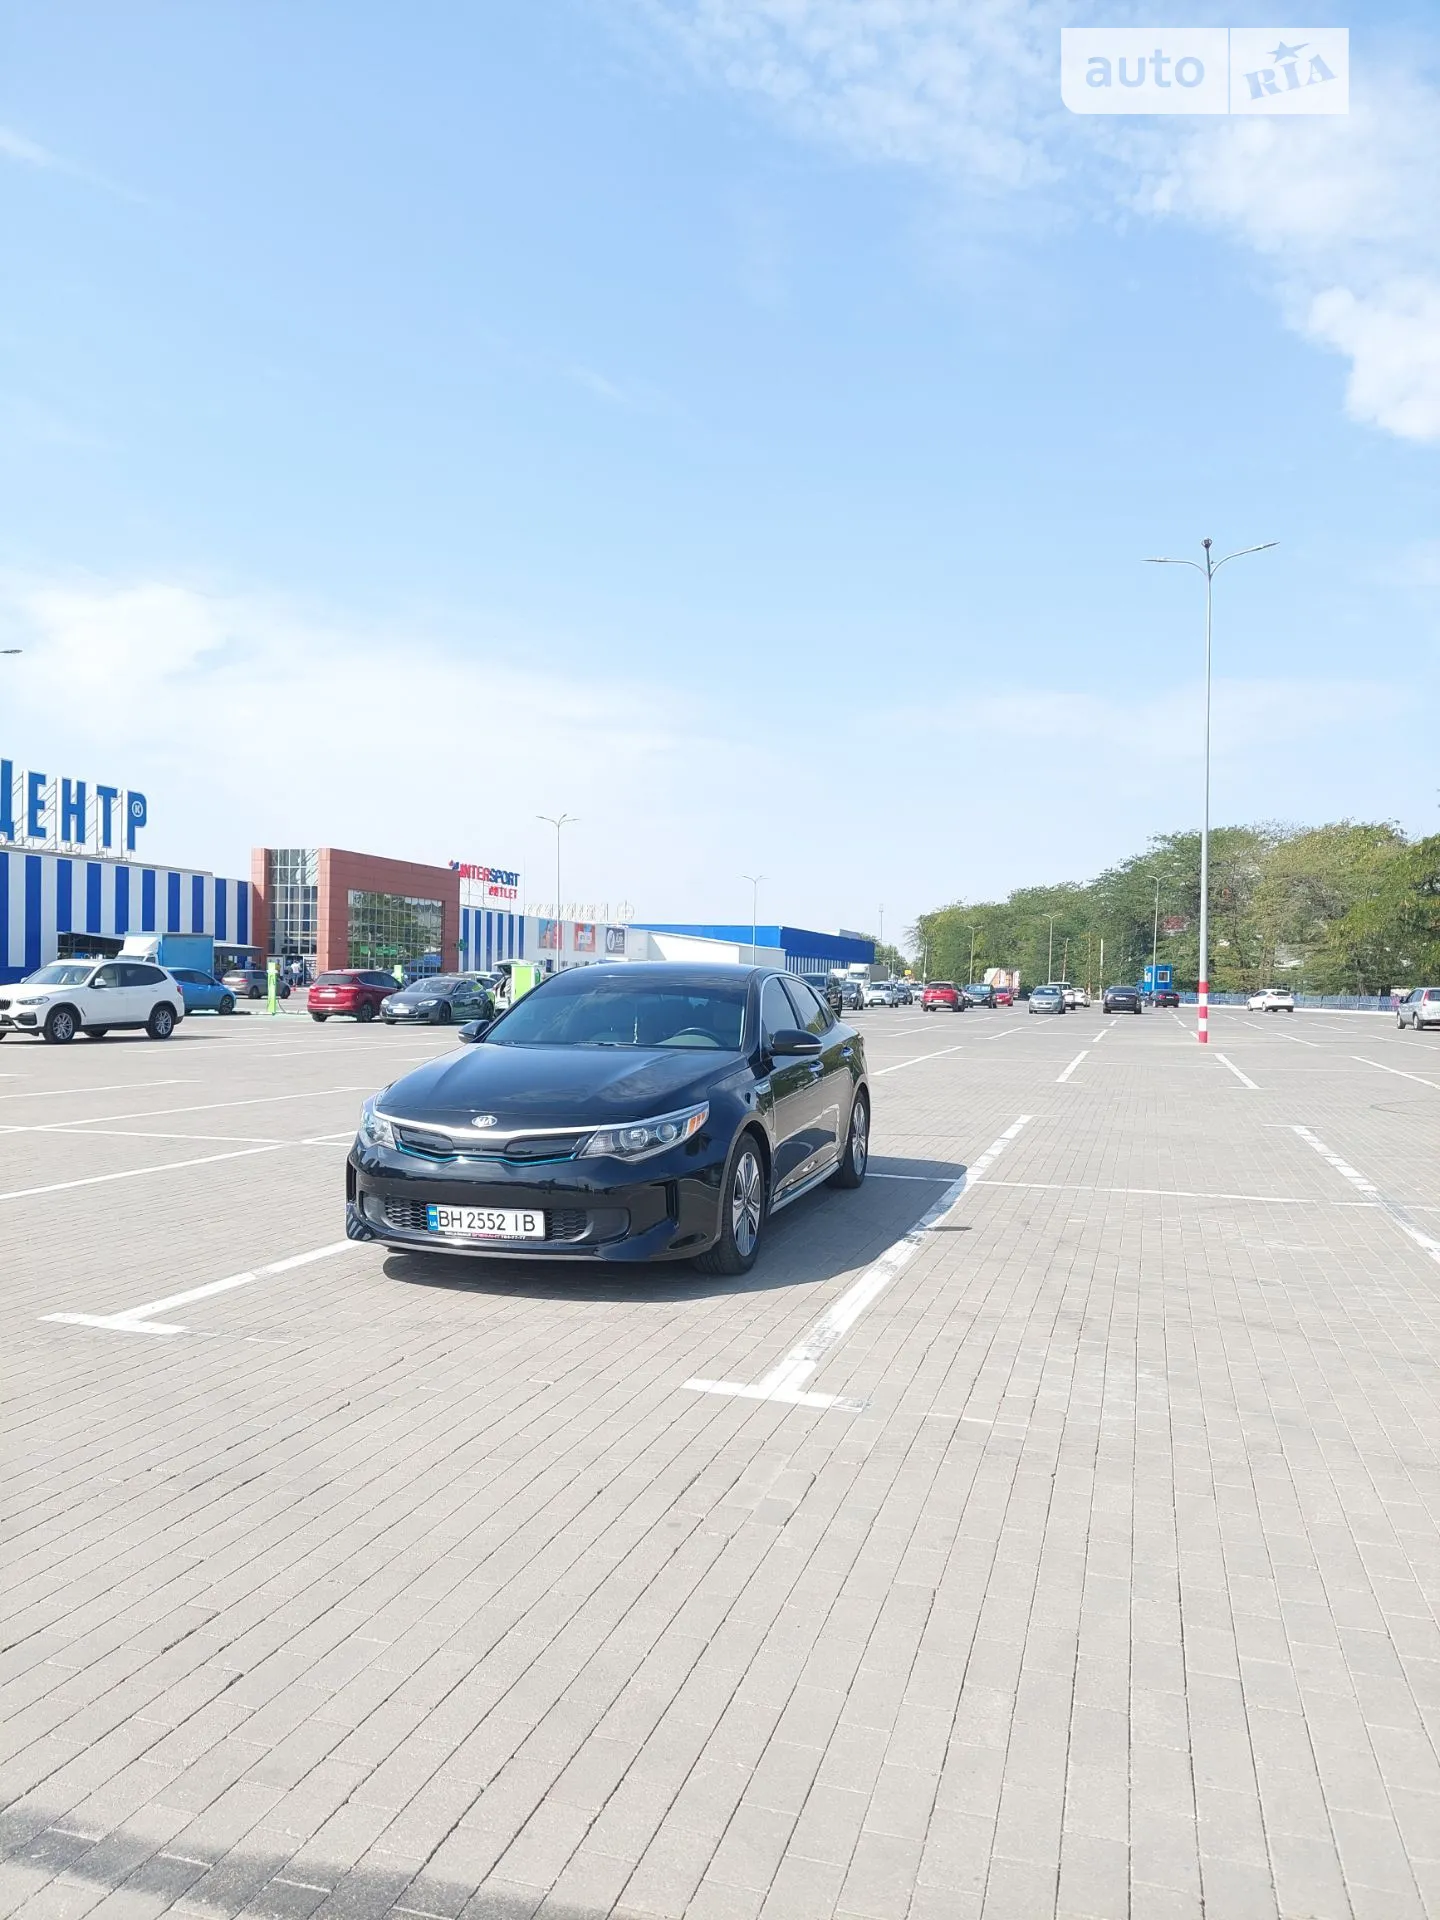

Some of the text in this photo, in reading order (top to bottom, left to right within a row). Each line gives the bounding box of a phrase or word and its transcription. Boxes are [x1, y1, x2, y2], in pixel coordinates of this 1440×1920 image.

[459, 863, 520, 887] INTERSPORT
[488, 885, 518, 899] OUTLET
[466, 1212, 506, 1231] 2552
